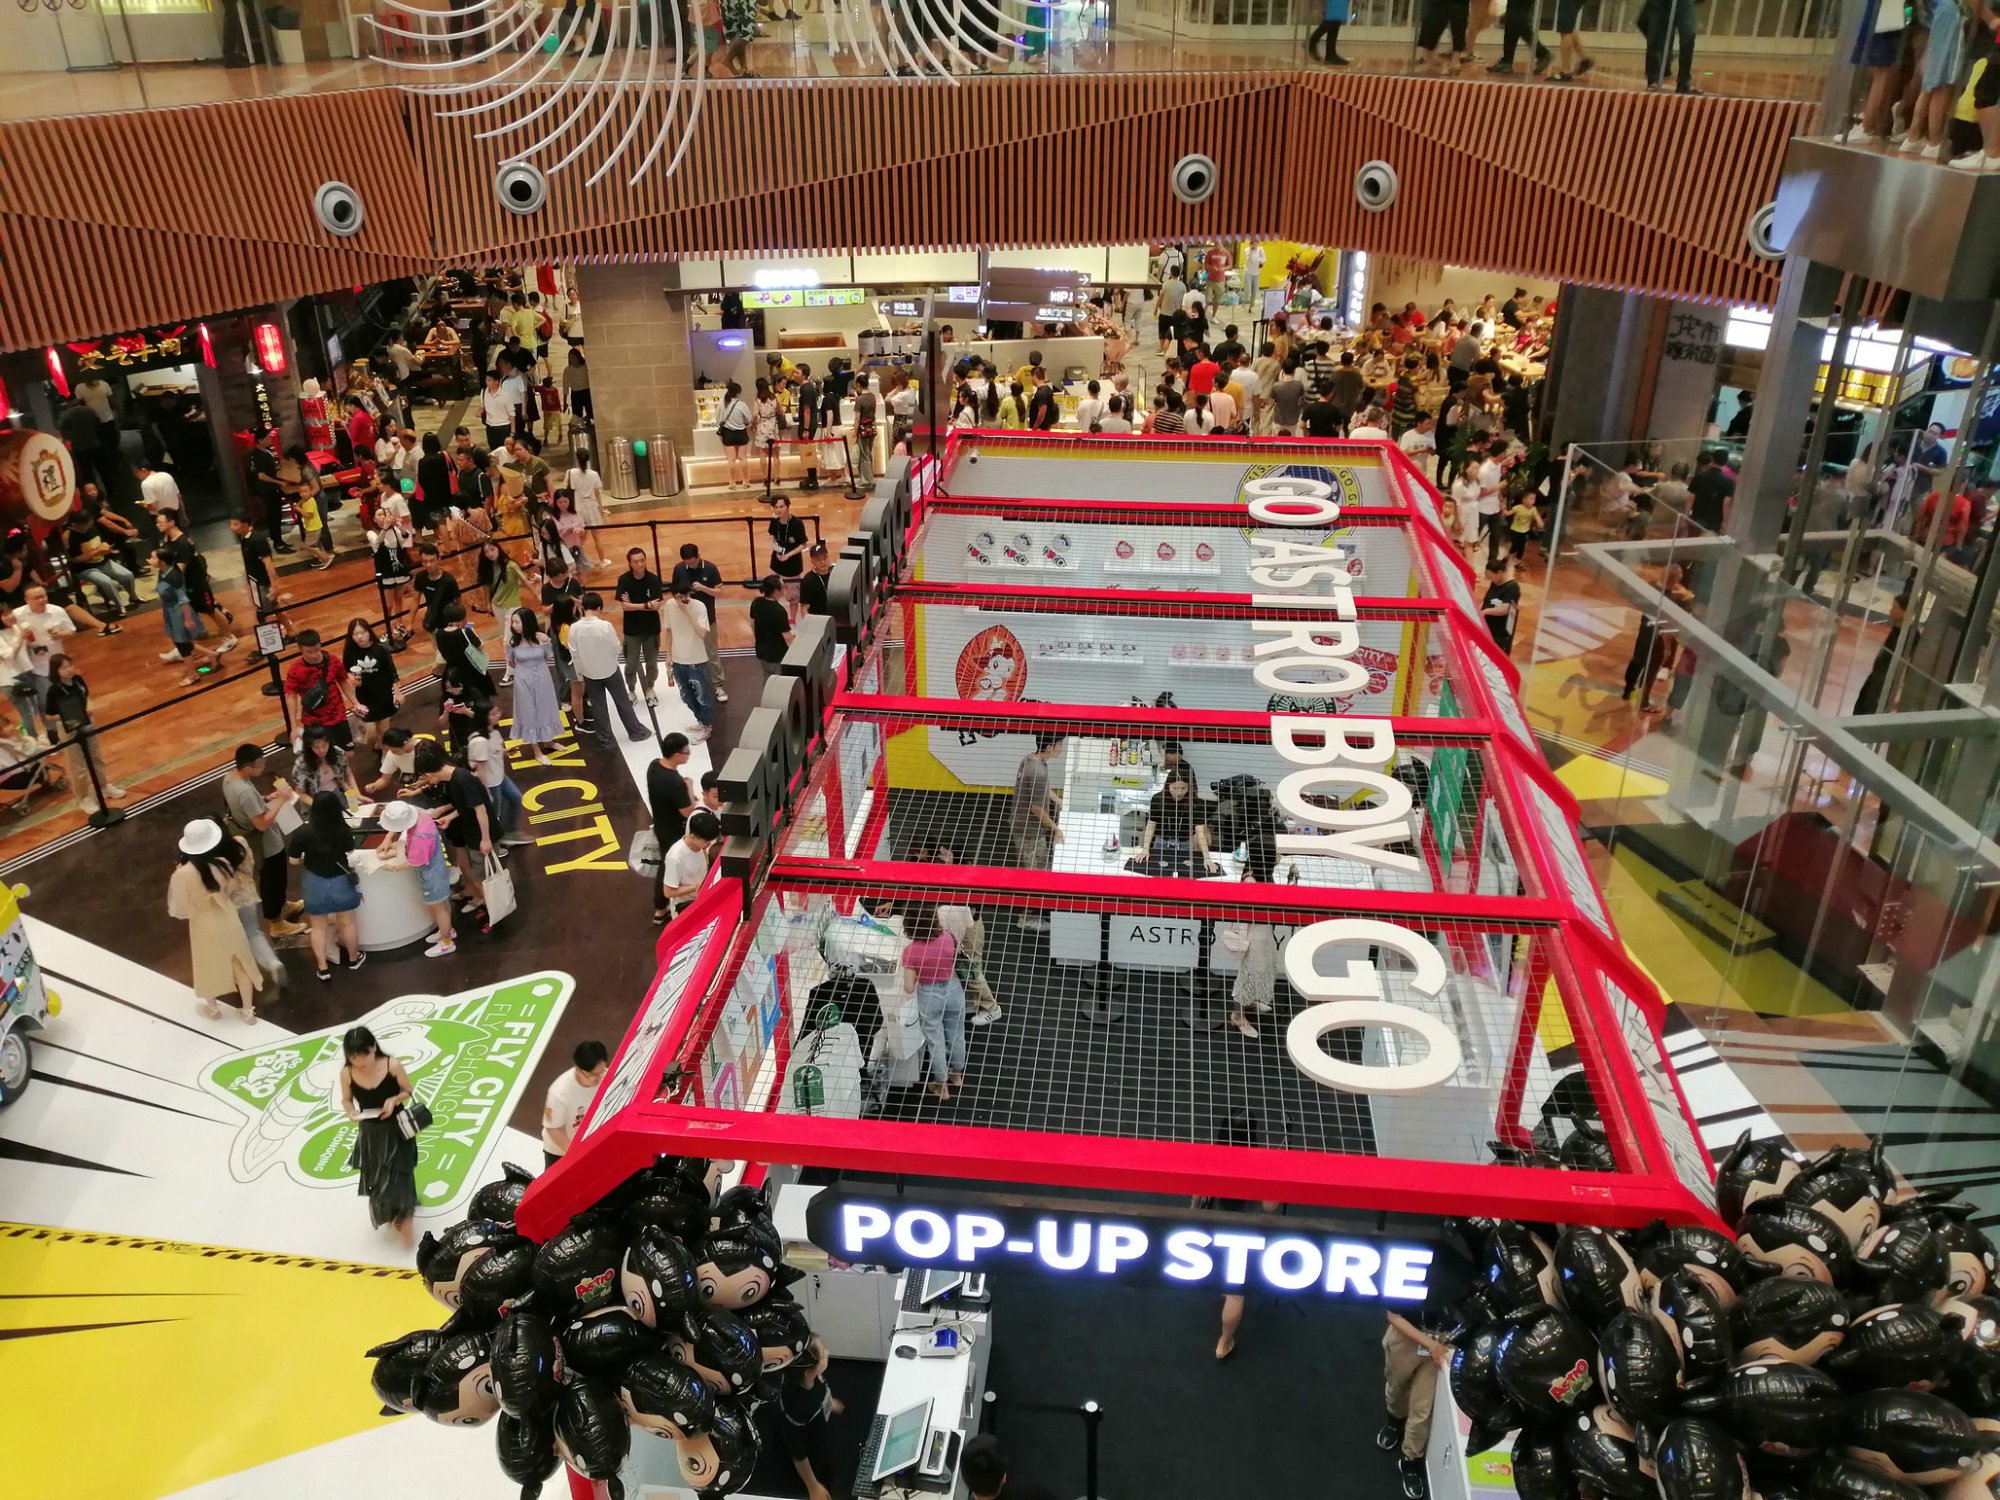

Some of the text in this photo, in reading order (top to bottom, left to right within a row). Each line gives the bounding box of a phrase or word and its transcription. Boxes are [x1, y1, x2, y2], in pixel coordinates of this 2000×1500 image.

[1244, 477, 1341, 526] GO
[1250, 537, 1369, 697] ASTRO
[521, 779, 629, 875] CITY
[1270, 715, 1421, 876] BOY
[485, 1003, 512, 1031] FLY
[1284, 918, 1461, 1096] GO
[443, 1021, 536, 1147] FLY CITY
[313, 1126, 349, 1172] CHONGQING
[842, 1205, 1434, 1300] POP-UP STORE
